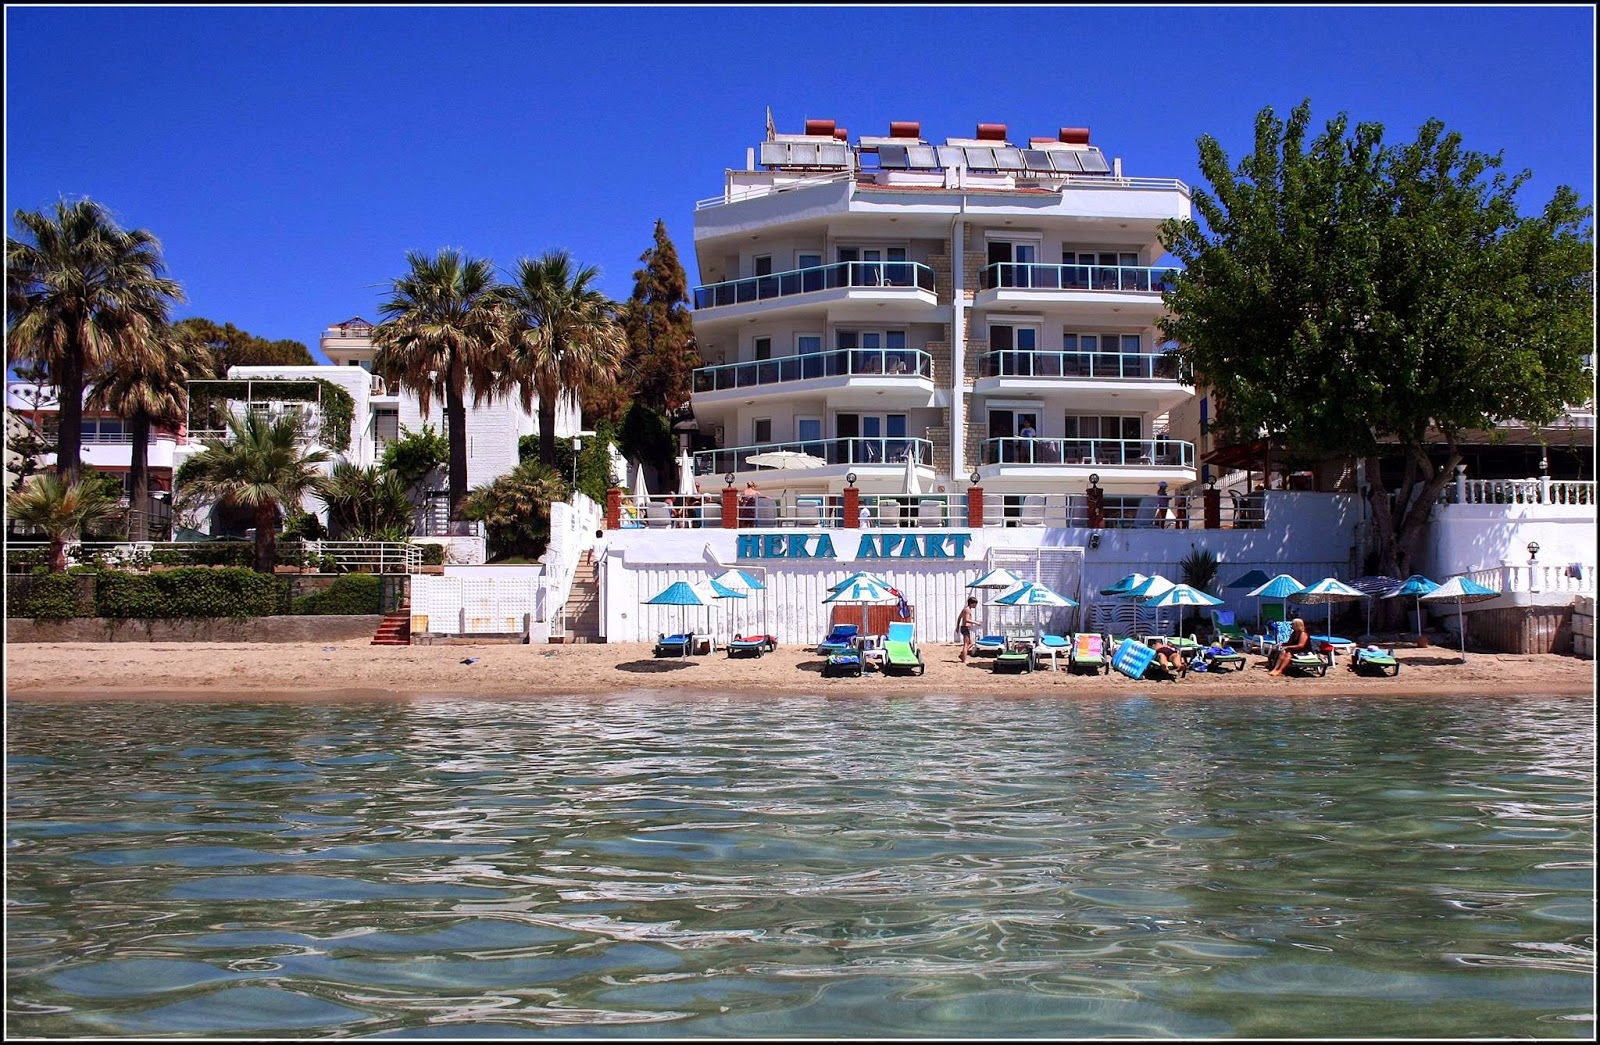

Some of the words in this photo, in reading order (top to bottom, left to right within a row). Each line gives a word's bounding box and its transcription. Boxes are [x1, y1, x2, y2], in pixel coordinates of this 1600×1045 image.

[737, 534, 837, 558] HERA
[856, 534, 972, 558] APART
[852, 583, 880, 599] H
